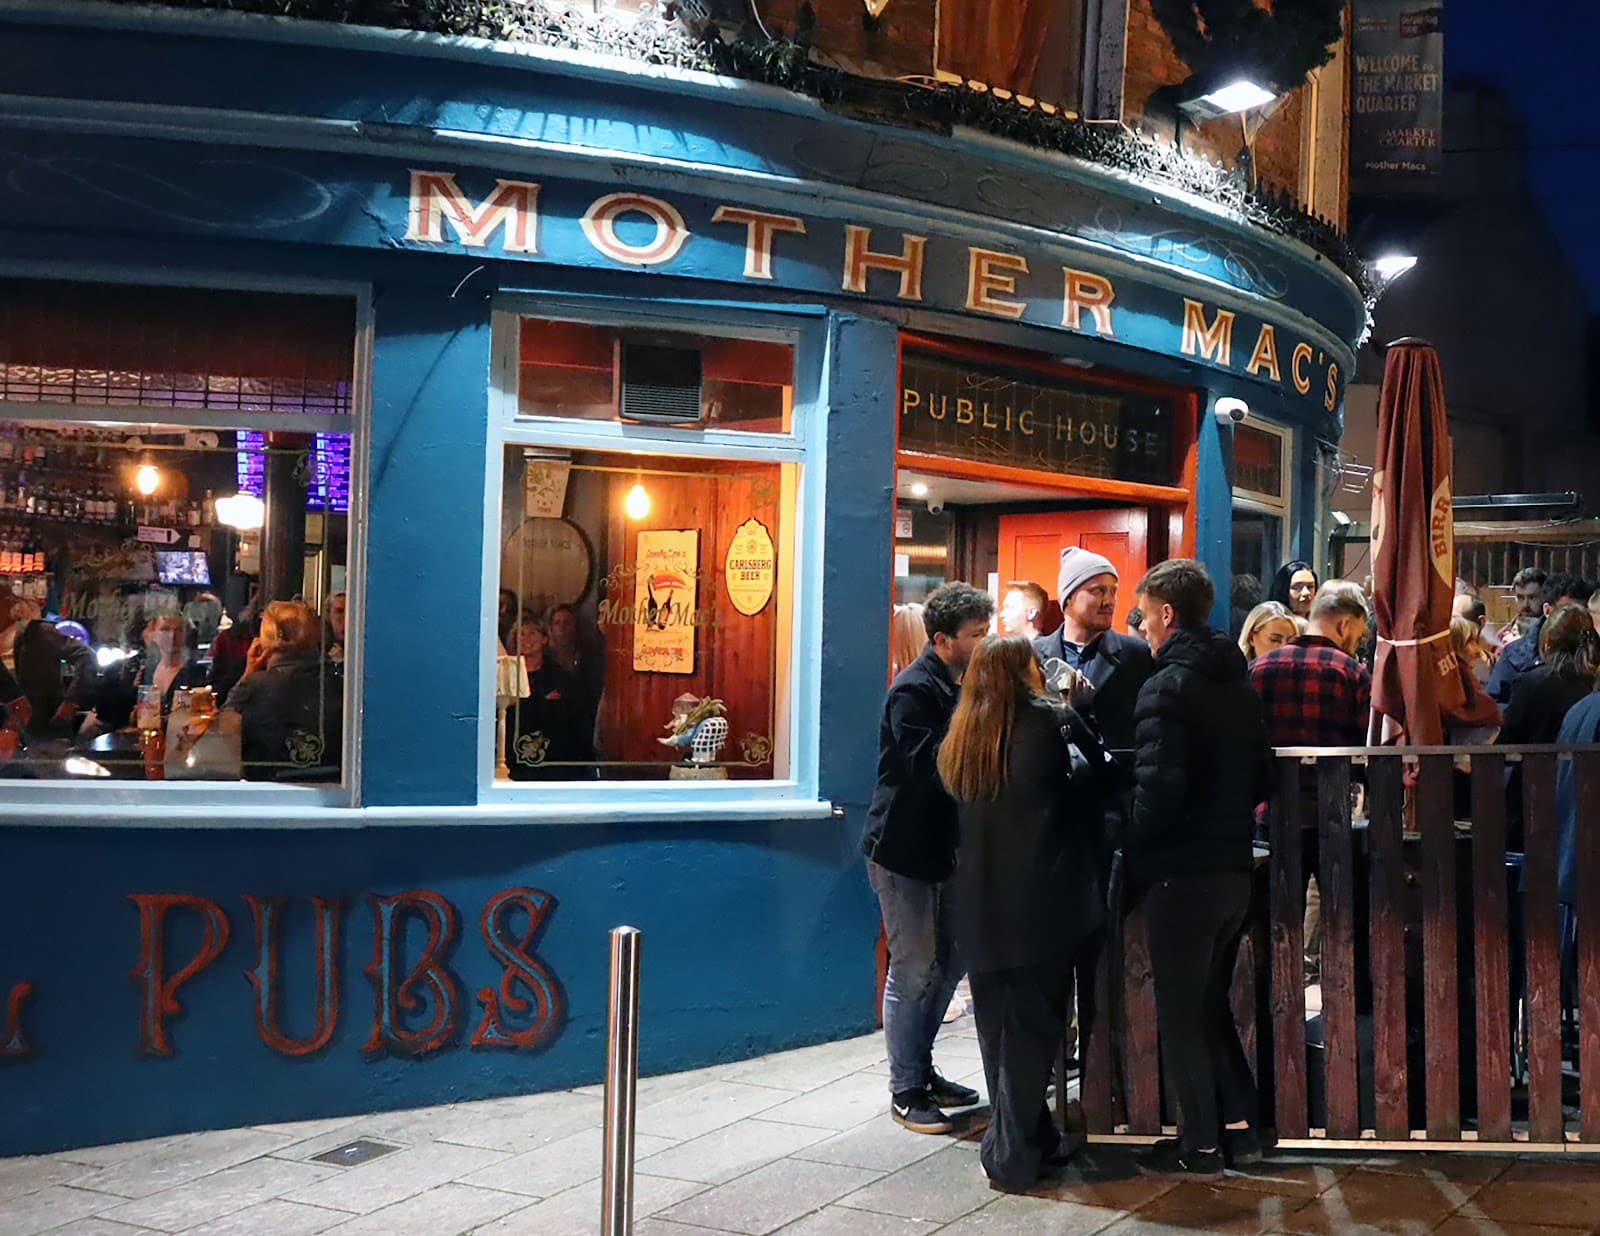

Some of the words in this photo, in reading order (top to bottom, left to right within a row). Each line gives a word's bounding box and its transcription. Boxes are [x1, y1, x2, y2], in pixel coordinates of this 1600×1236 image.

[1356, 55, 1420, 73] WELCOME
[1358, 76, 1381, 93] THE
[1384, 73, 1439, 92] MARKET
[1356, 95, 1417, 113] QUARTER
[1385, 128, 1435, 138] MARKET
[404, 168, 1116, 336] MOTHER
[1180, 298, 1338, 412] MAC'S
[902, 388, 1035, 435] PUBLIC
[1055, 415, 1160, 456] HOUSE
[729, 559, 772, 571] CARLSBERG
[740, 571, 761, 581] BEER
[126, 886, 562, 1056] PUBS
